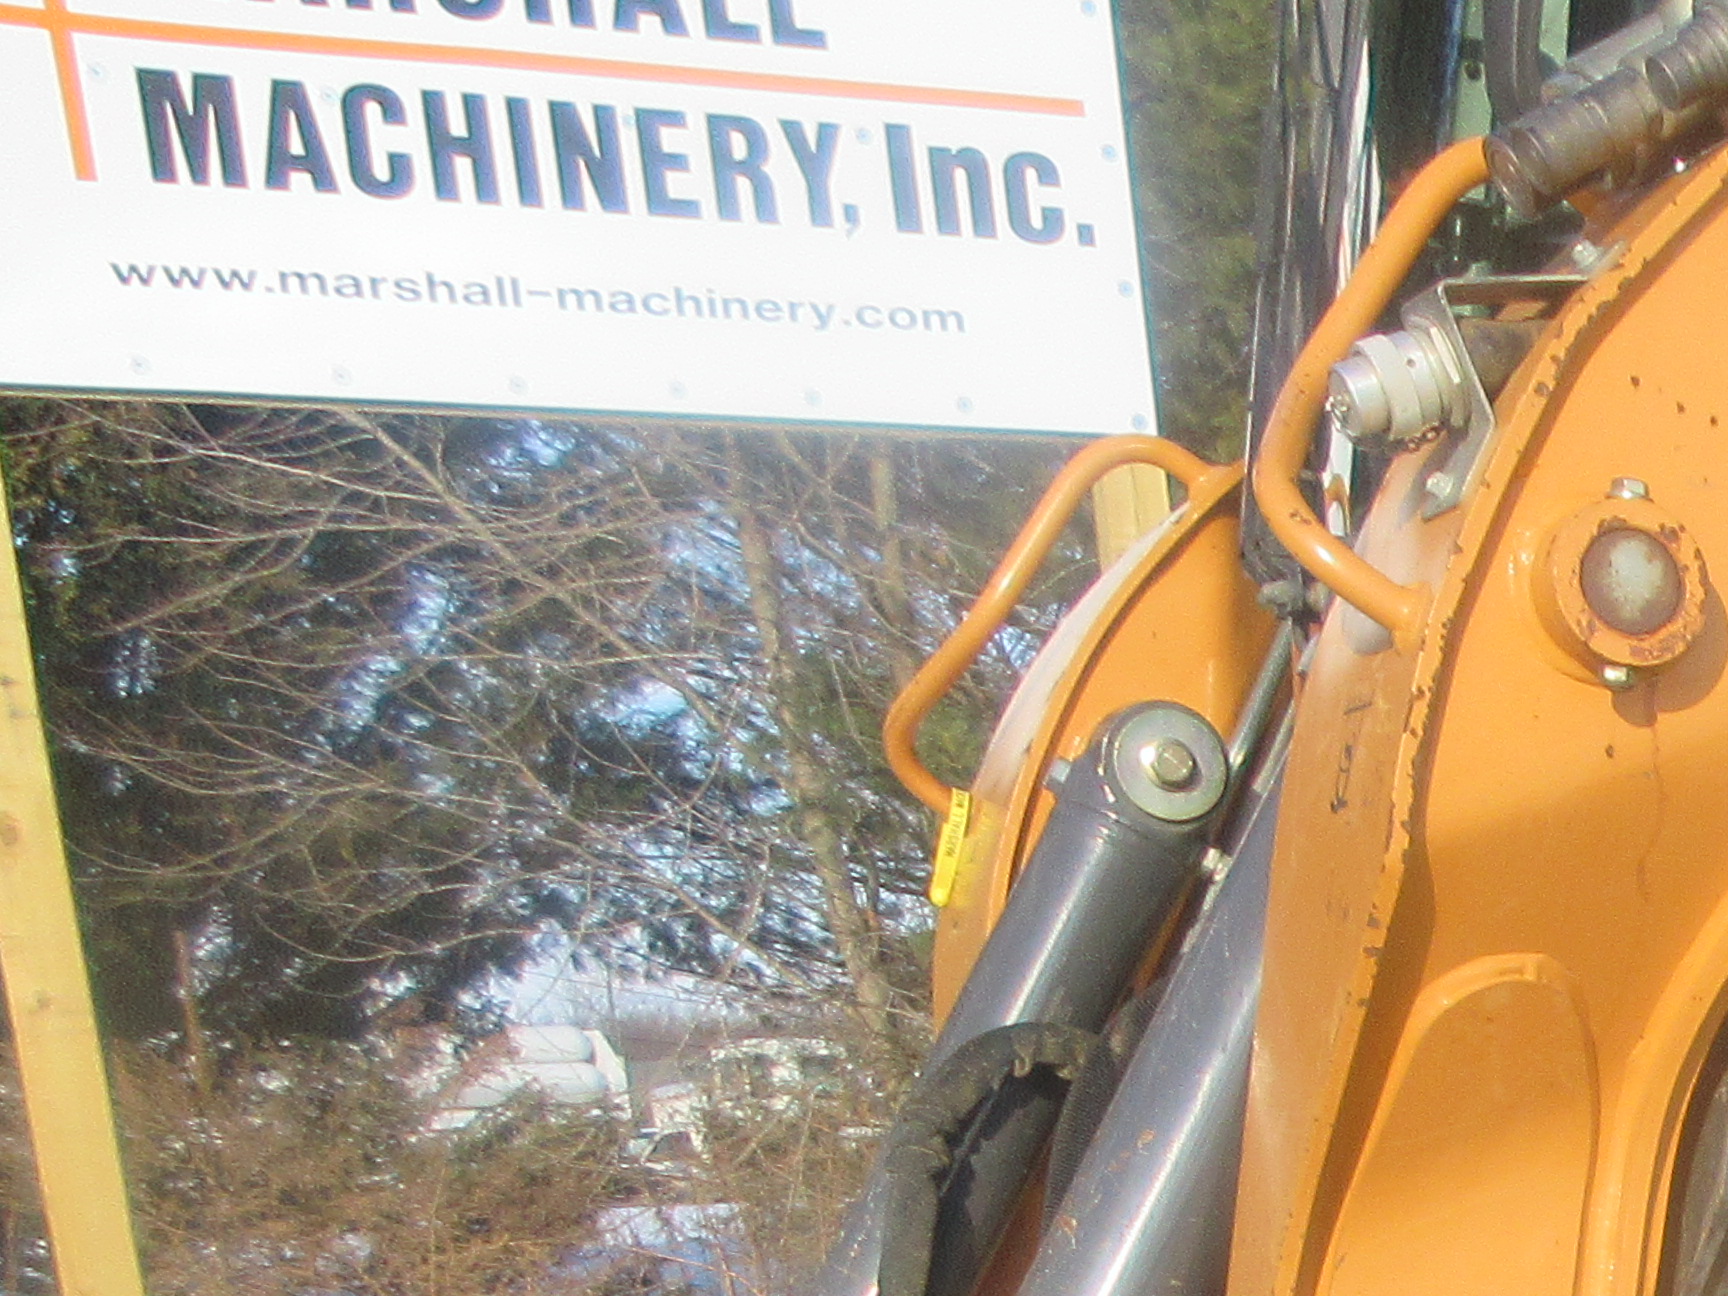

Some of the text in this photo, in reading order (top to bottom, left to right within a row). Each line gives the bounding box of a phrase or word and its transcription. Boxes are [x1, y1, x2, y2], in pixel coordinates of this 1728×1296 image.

[134, 66, 1095, 246] MACHINERY, Inc.
[109, 261, 967, 333] www.marshall-machinery.com
